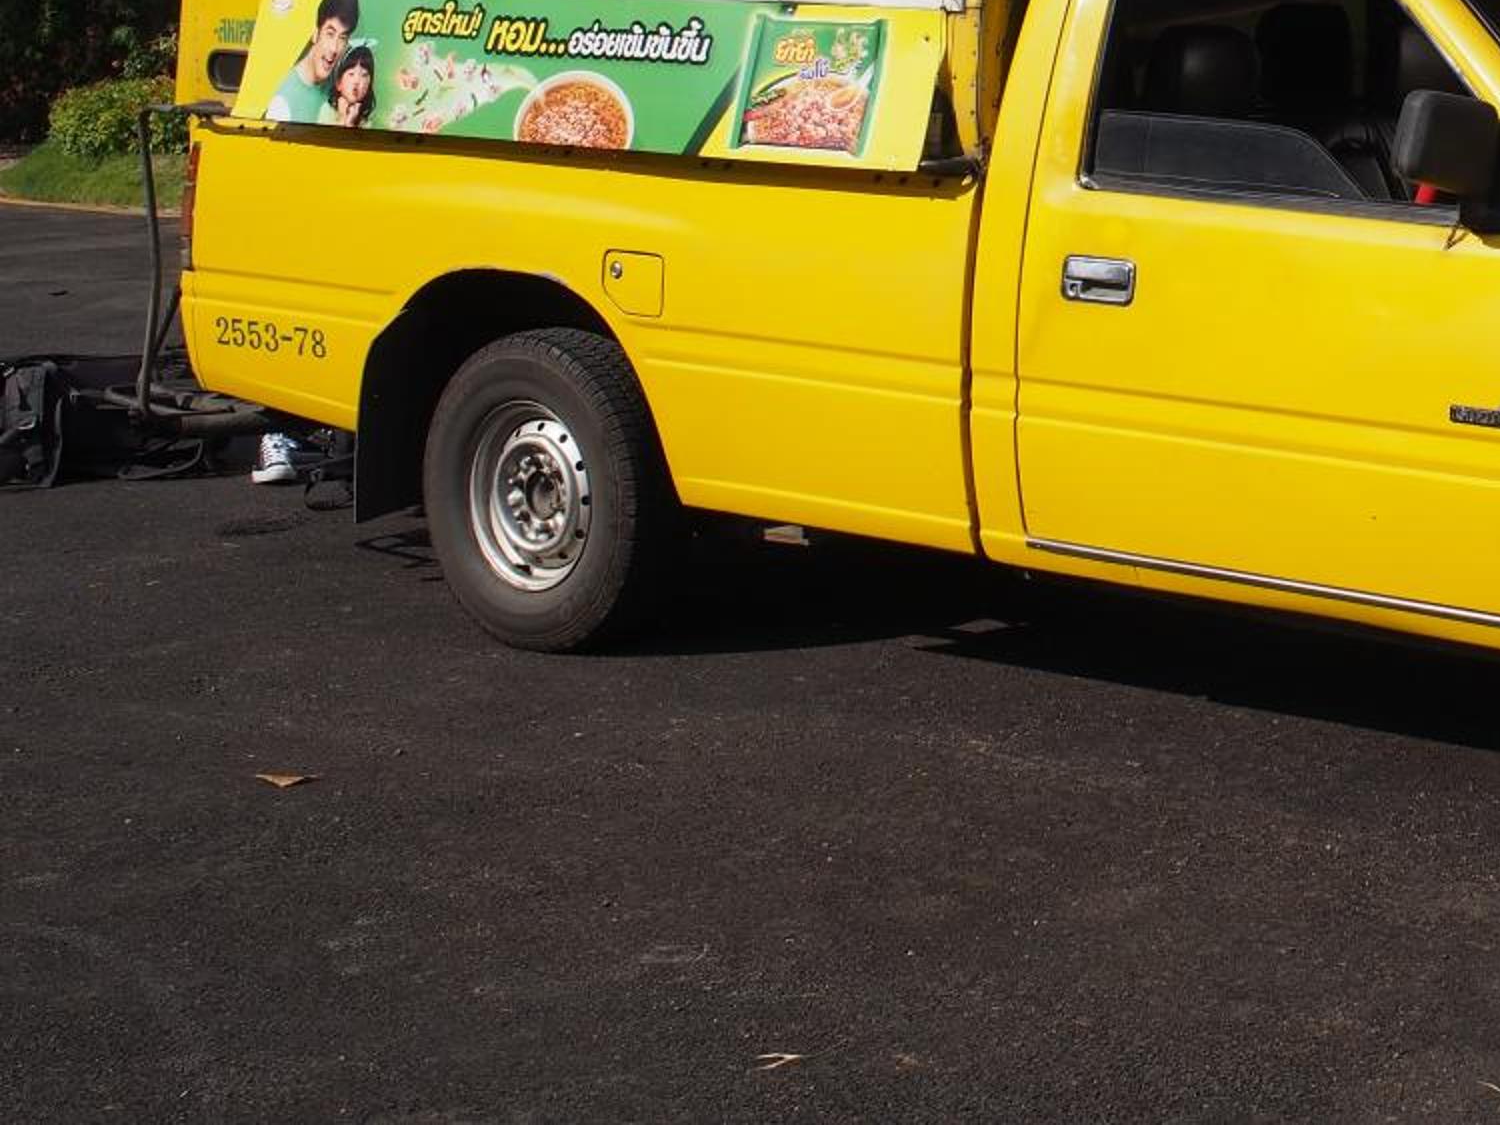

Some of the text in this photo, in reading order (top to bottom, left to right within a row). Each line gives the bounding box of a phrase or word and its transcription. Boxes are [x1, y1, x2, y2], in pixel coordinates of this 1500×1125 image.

[403, 1, 481, 43] สูตรใหม่!
[216, 316, 327, 358] 2553-78
